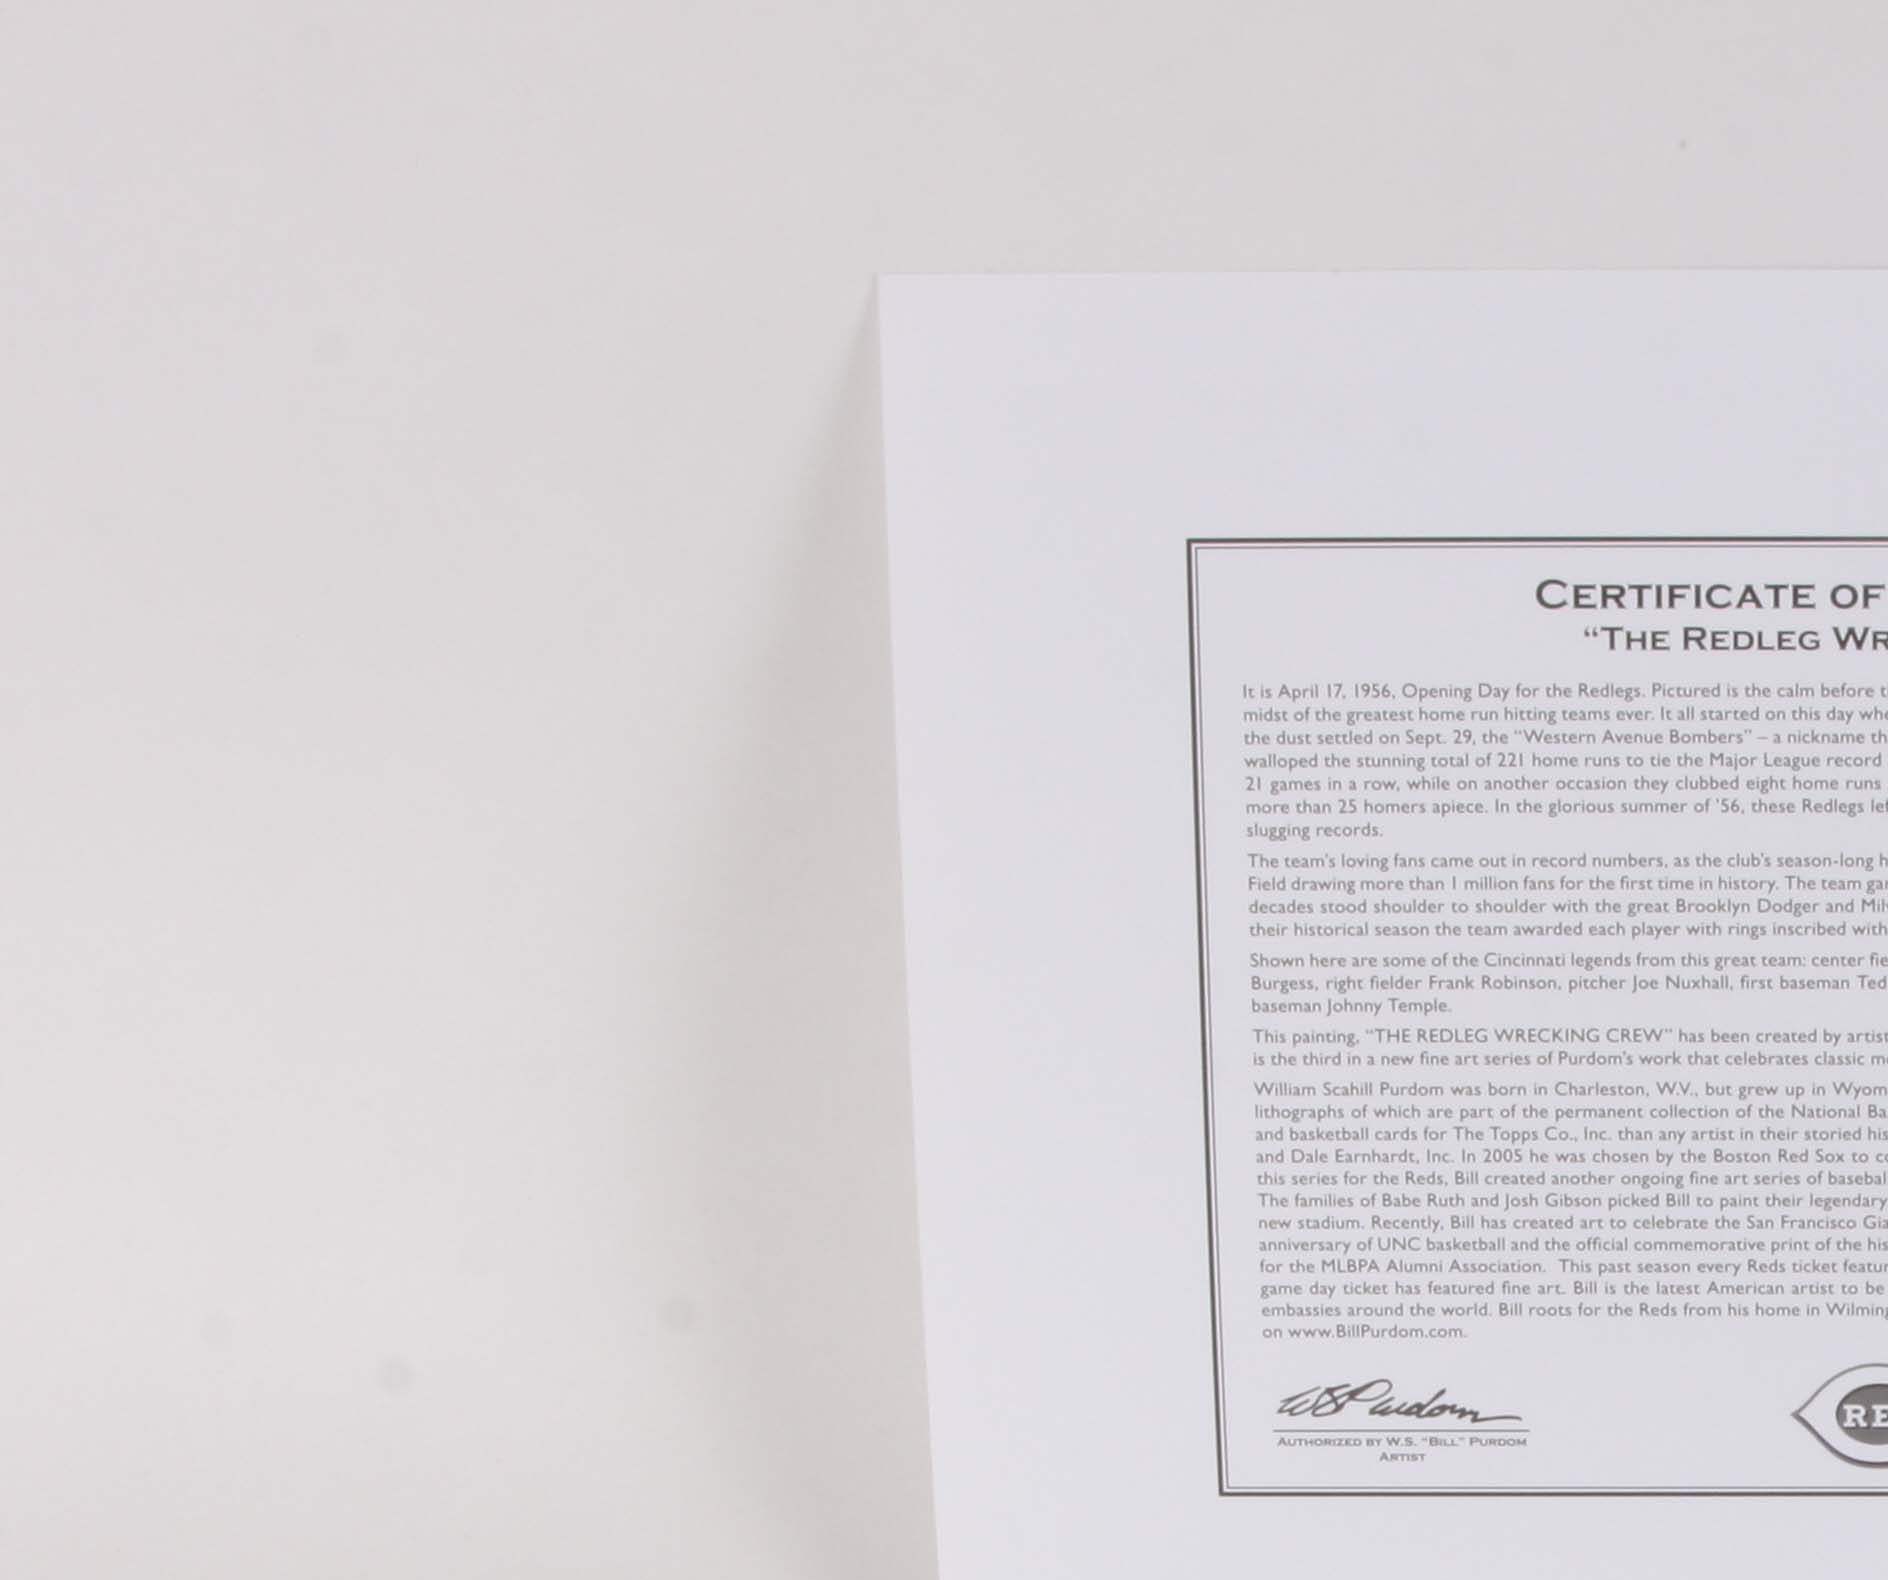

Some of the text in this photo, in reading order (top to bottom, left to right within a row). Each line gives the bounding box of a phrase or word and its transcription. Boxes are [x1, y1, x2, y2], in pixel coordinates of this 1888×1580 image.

[1535, 578, 1816, 610] CERTIFICATE
[1830, 584, 1886, 610] OF
[1683, 626, 1821, 651] REDLEG
[1242, 683, 1256, 699] It
[1260, 684, 1273, 699] is
[1277, 683, 1319, 703] April
[1401, 682, 1473, 703] Opening
[1478, 682, 1511, 703] Day
[1515, 682, 1540, 698] for
[1545, 682, 1573, 698] the
[1652, 682, 1721, 698] Pictured
[1726, 683, 1739, 698] is
[1744, 682, 1771, 698] the
[1776, 682, 1815, 698] calm
[1820, 682, 1875, 698] before
[1246, 822, 1311, 842] slugging
[1251, 998, 1322, 1013] baseman
[1326, 997, 1383, 1017] Johnny
[1258, 1237, 1351, 1256] anniversary
[1356, 1236, 1374, 1252] of
[1377, 1236, 1421, 1252] UNC
[1426, 1236, 1505, 1252] basketball
[1511, 1236, 1539, 1251] and
[1544, 1236, 1571, 1252] the
[1575, 1236, 1628, 1252] official
[1633, 1237, 1766, 1252] commemorative
[1771, 1237, 1810, 1255] print
[1815, 1236, 1832, 1252] of
[1836, 1237, 1862, 1252] the
[1262, 1328, 1283, 1339] on
[1468, 1435, 1527, 1447] PURDOM
[1379, 1451, 1426, 1463] ARTIST
